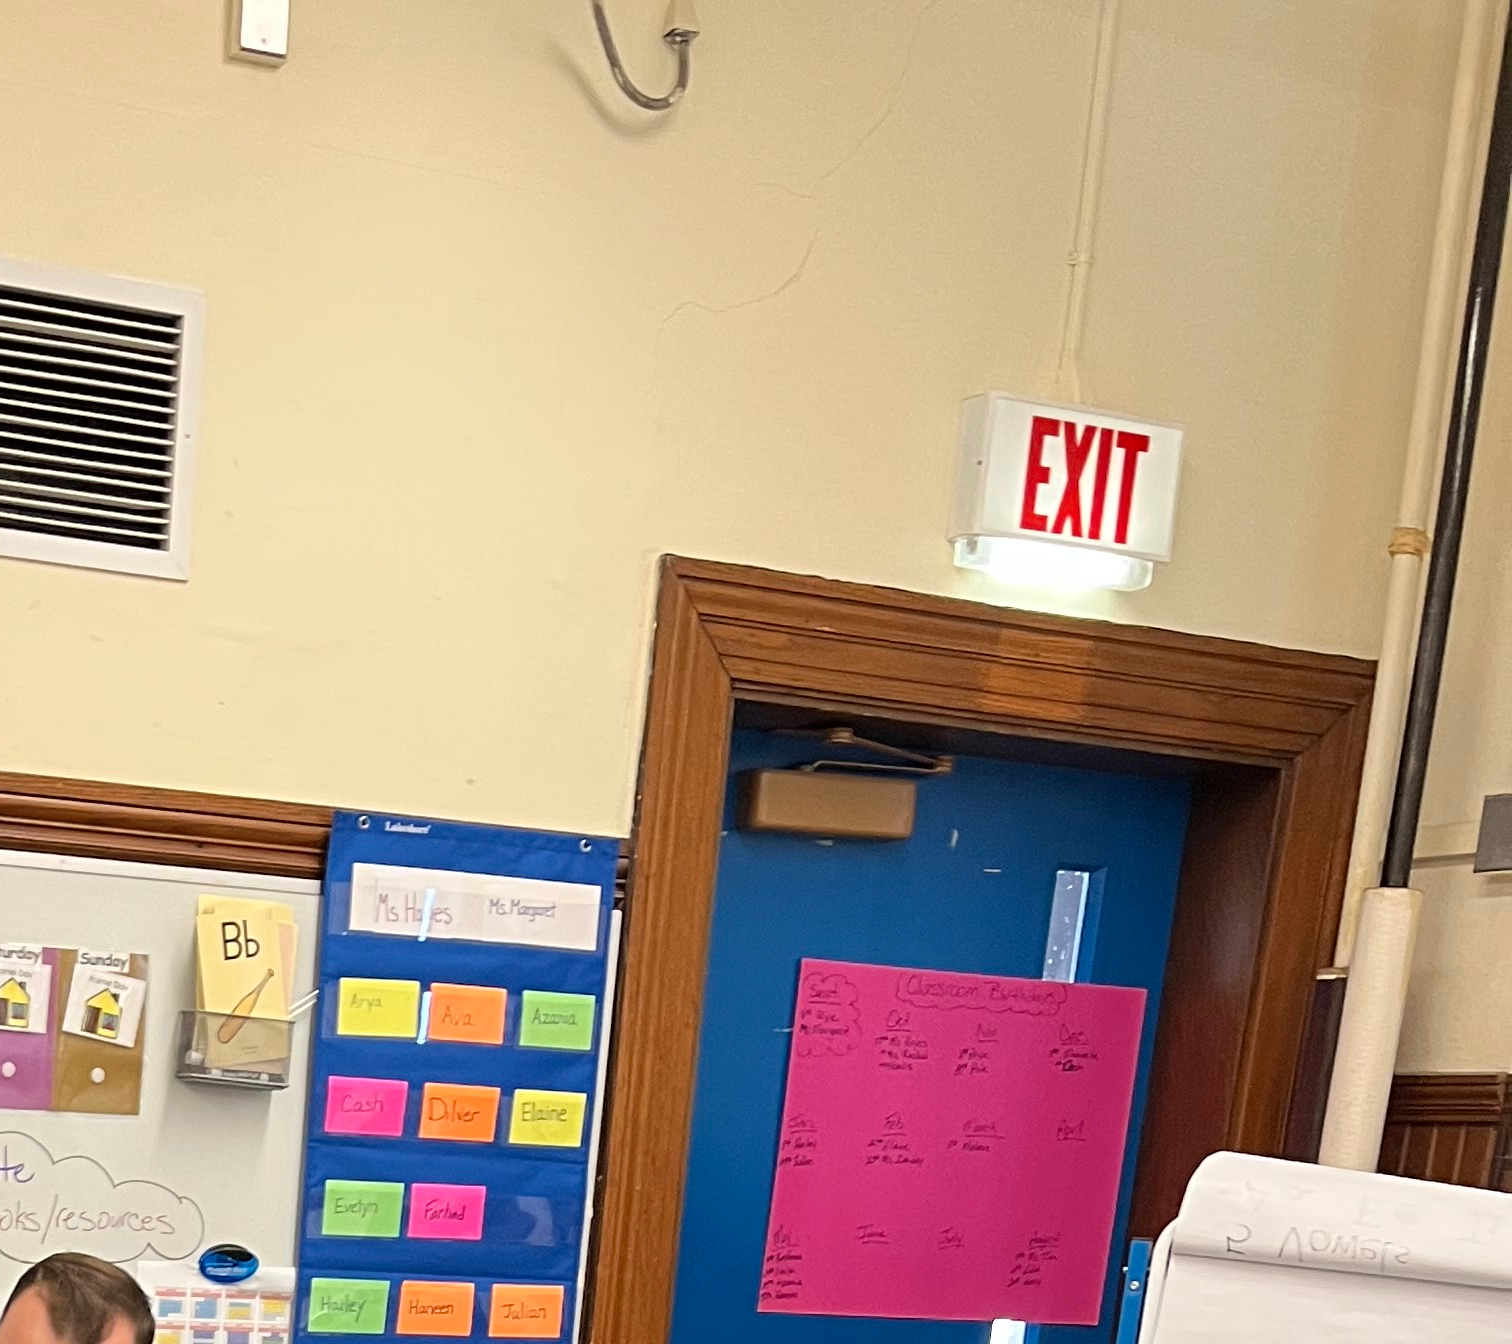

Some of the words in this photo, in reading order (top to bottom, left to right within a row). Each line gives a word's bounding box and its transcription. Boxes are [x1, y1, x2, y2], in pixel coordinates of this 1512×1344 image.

[1019, 415, 1150, 545] EXIT
[404, 892, 453, 924] Haes
[221, 919, 261, 961] Bb
[80, 952, 128, 972] Sunday
[442, 1006, 473, 1027] Ava
[341, 1094, 384, 1114] Cash
[521, 1102, 568, 1124] Elaine
[334, 1198, 378, 1218] Evelyn
[501, 1302, 546, 1319] Julian
